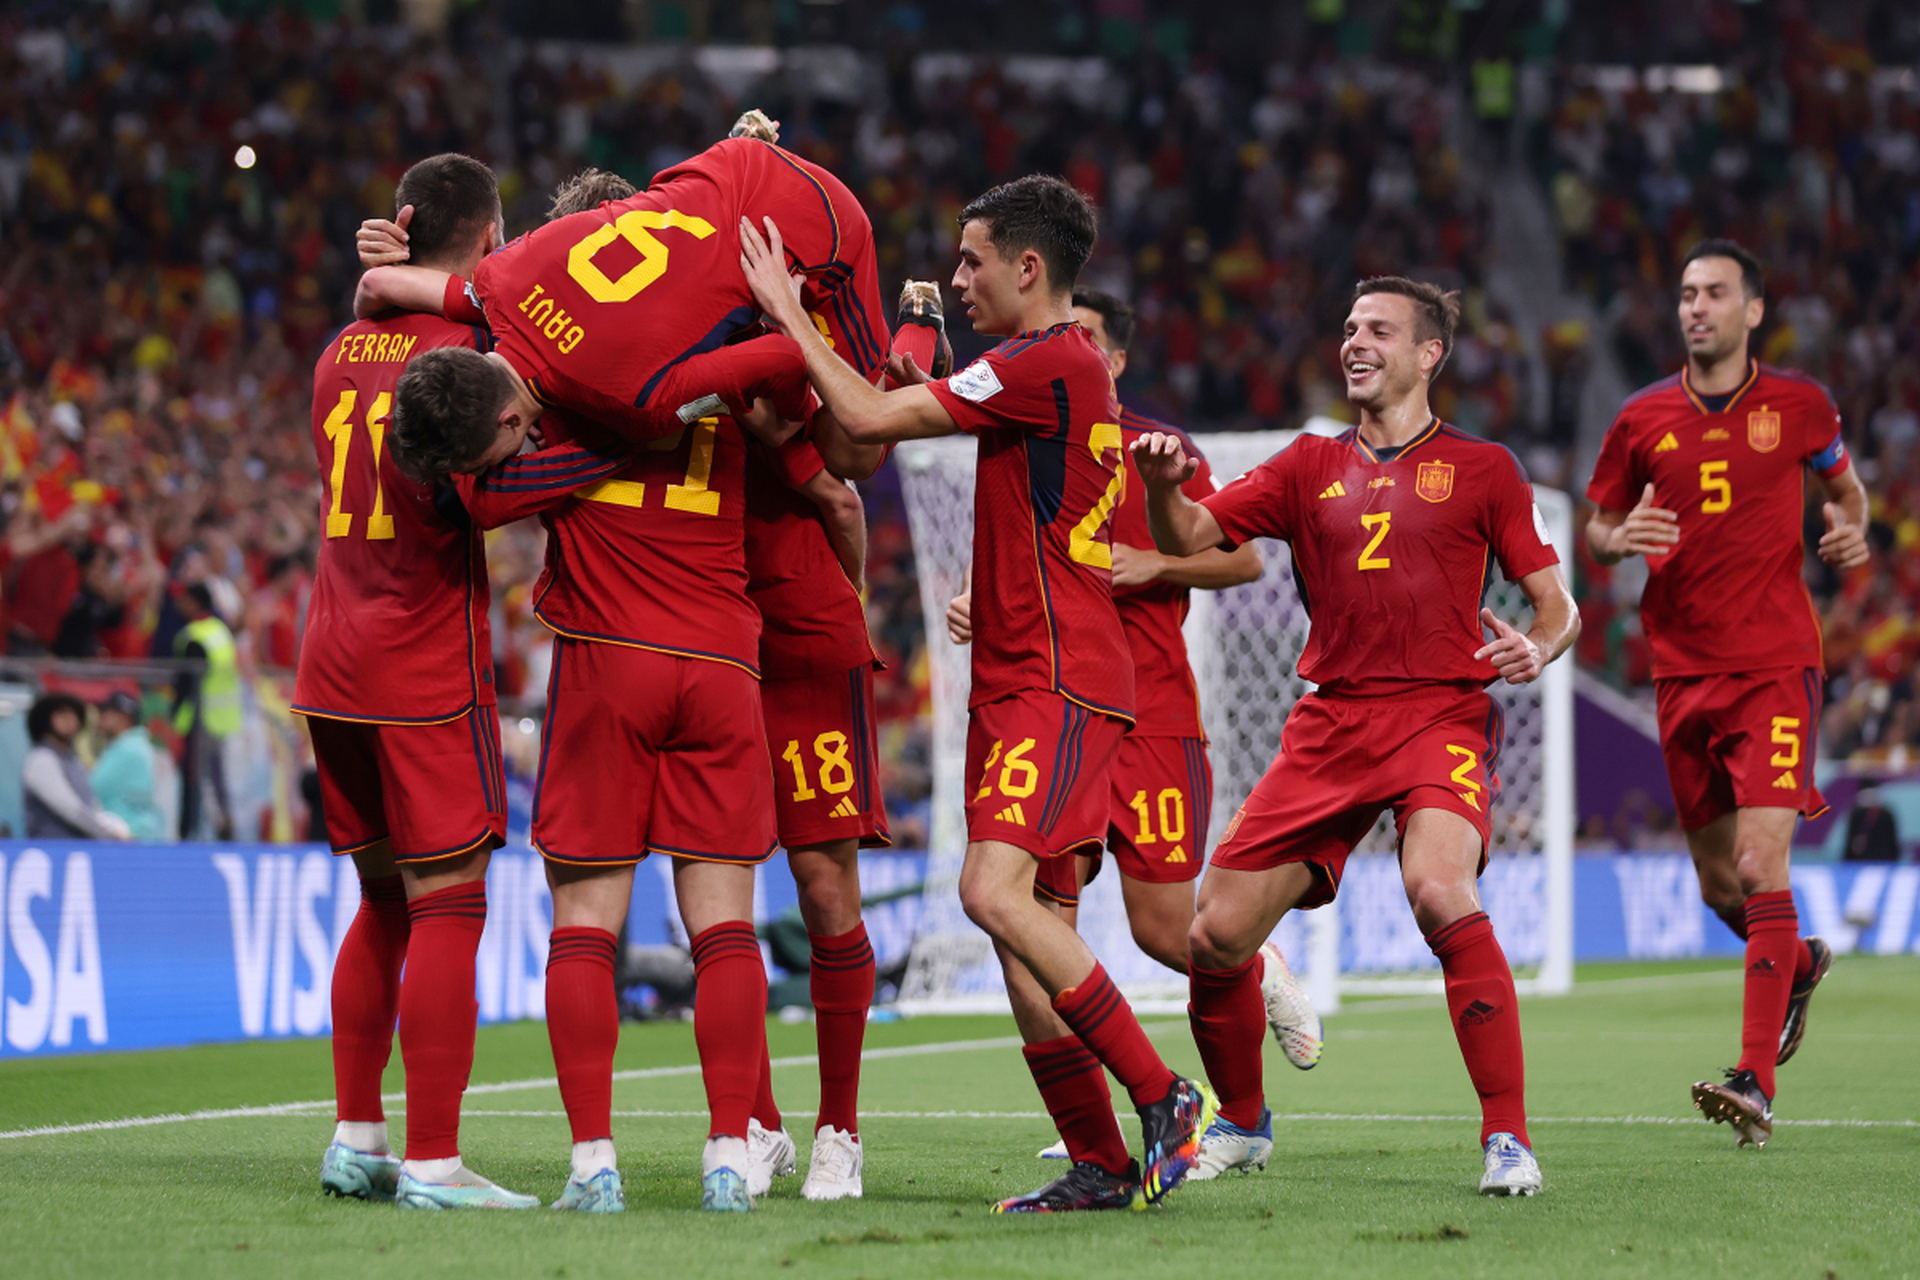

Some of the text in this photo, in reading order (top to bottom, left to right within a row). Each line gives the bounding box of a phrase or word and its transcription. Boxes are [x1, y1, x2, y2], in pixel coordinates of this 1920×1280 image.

[517, 284, 585, 354] GAVI
[335, 333, 418, 364] FERRAN
[323, 390, 395, 540] 11
[1698, 459, 1732, 514] 5
[1357, 510, 1391, 571] 2
[782, 730, 855, 802] 18
[1444, 743, 1481, 792] 2
[1769, 715, 1800, 768] 5
[1129, 787, 1186, 845] 10
